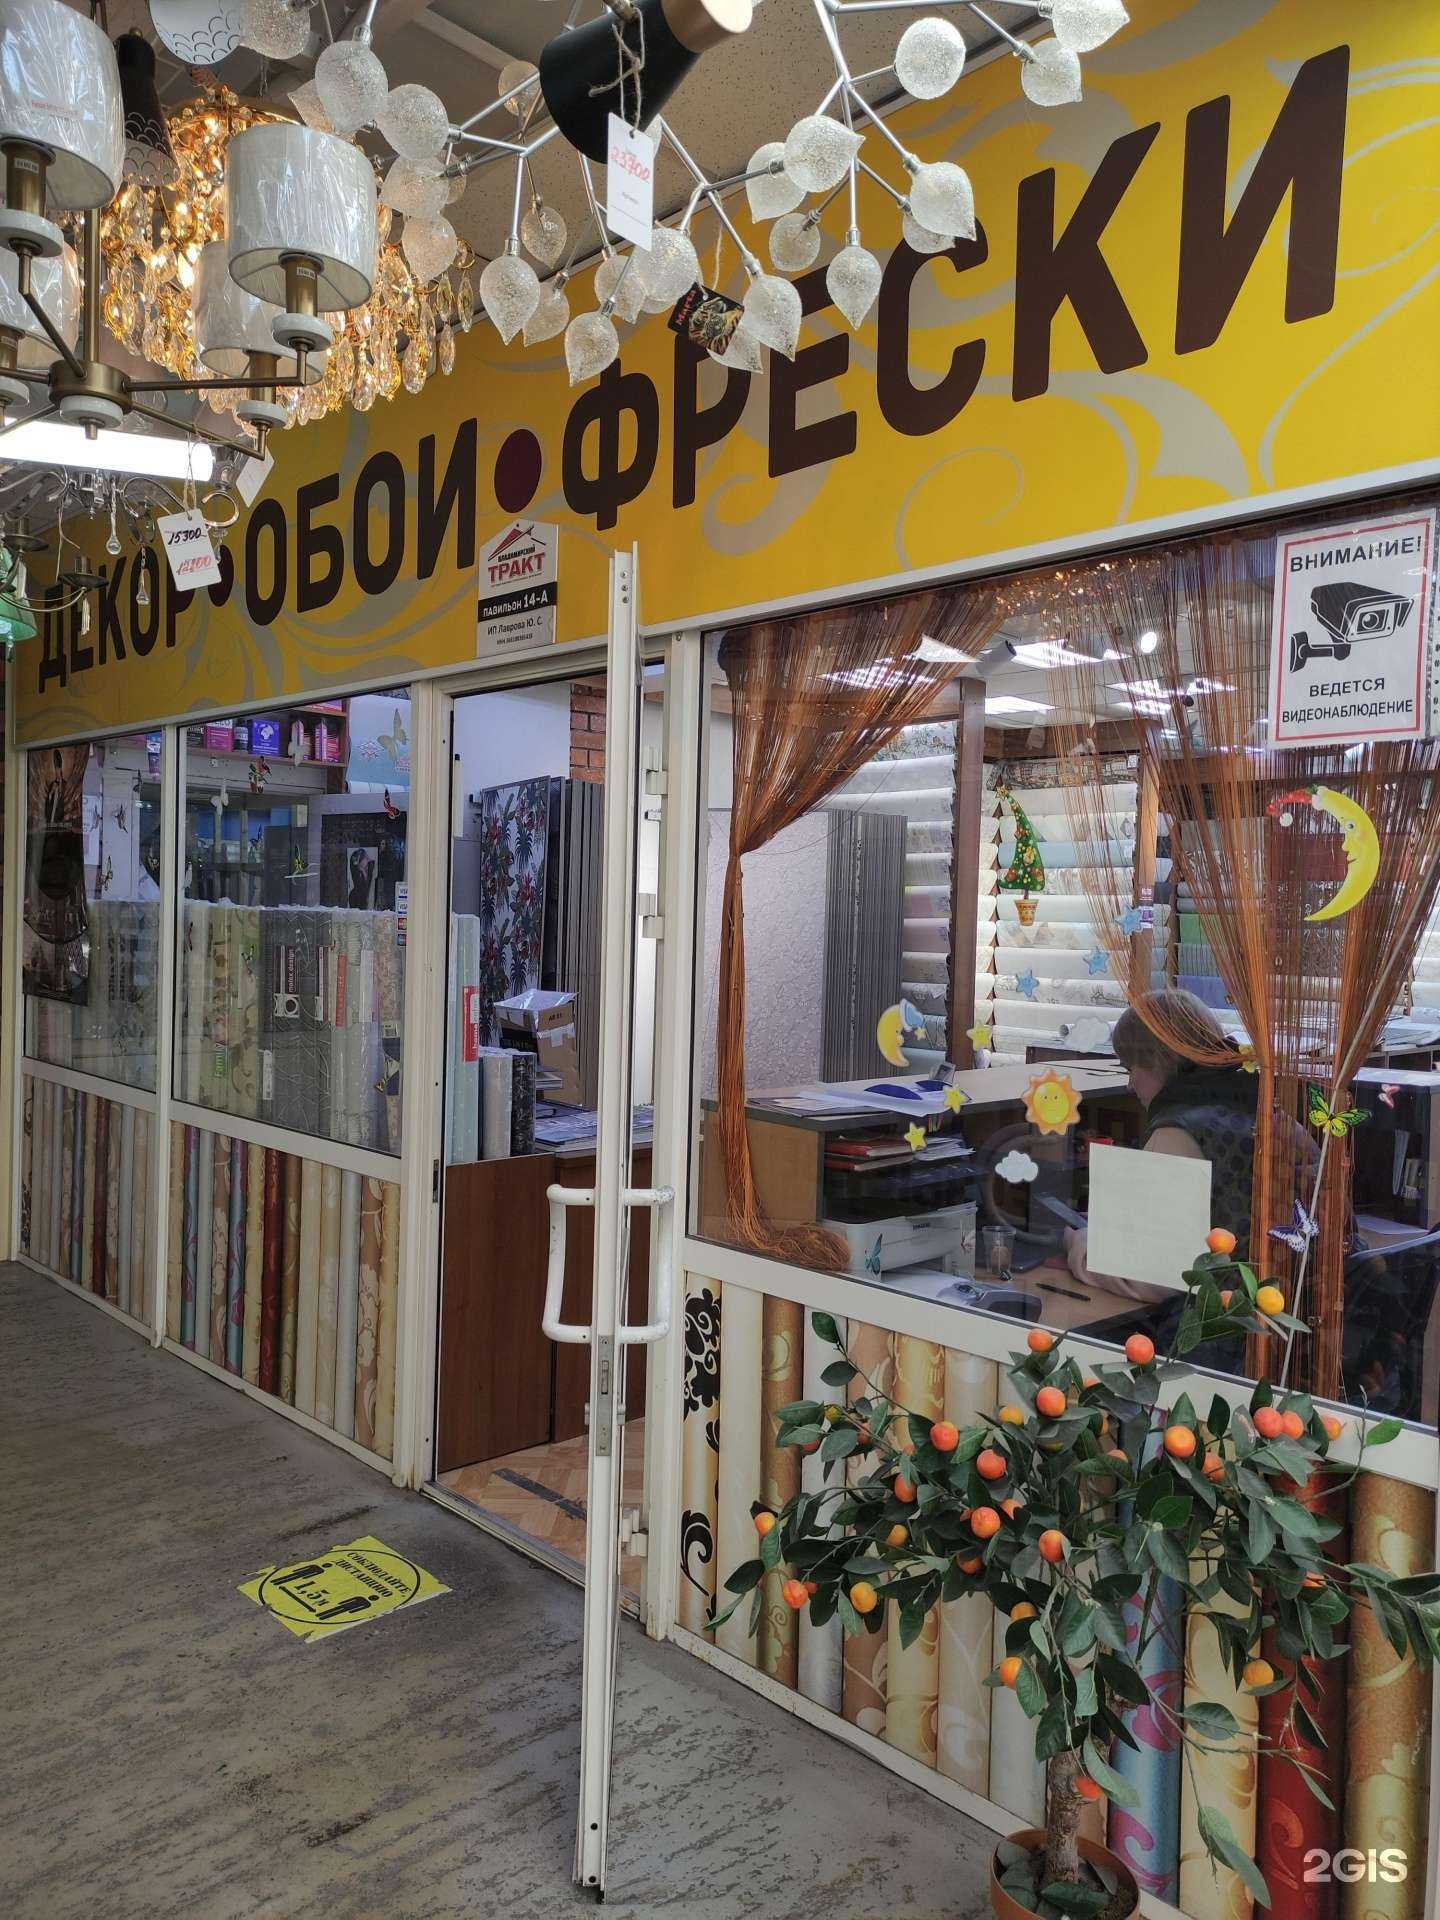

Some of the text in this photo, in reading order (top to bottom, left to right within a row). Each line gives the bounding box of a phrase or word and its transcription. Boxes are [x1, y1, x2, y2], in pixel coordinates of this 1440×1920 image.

[245, 418, 478, 627] ОБОИ
[561, 44, 1350, 532] ФРЕСКИ
[1290, 535, 1422, 573] ВНИМАНИЕ!
[487, 553, 546, 584] ТРАКТ
[483, 599, 522, 618] ПАВИЛЬОН
[487, 624, 498, 636] ИП
[498, 620, 526, 634] Лаврова
[1309, 677, 1386, 698] ВЕДЕТСЯ
[1282, 699, 1413, 724] ВИДЕОНАБЛЮДЕНИЕ
